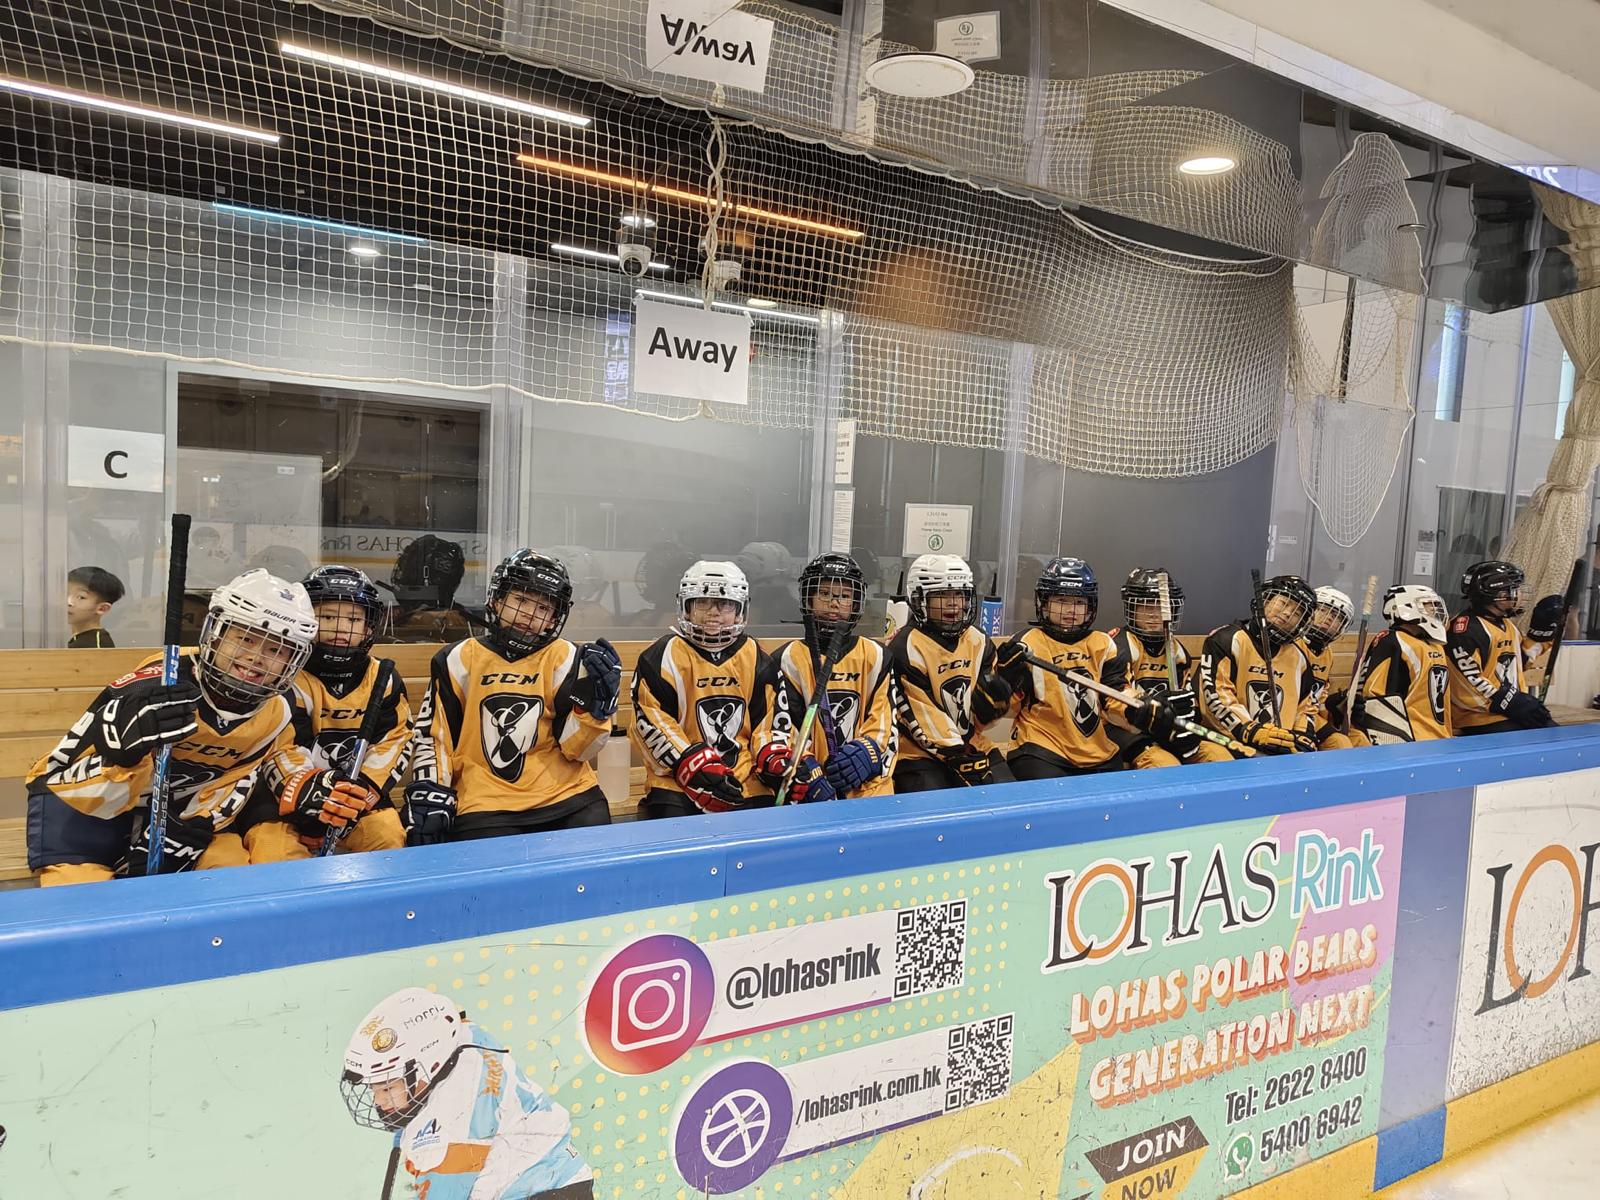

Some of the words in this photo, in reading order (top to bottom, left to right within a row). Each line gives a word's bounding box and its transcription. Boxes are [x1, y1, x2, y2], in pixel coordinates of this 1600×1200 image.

[648, 327, 737, 373] Away
[104, 450, 128, 479] C
[330, 578, 358, 586] CCM
[536, 572, 560, 585] CCM
[263, 608, 297, 625] BAUER
[938, 659, 971, 675] CCM
[1052, 651, 1092, 665] CCM
[480, 672, 540, 686] CCM
[696, 676, 740, 688] CCM
[172, 741, 243, 760] CCM
[158, 775, 172, 846] JETSPEED
[1045, 841, 1278, 968] LOHAS
[1291, 833, 1383, 914] Rink
[726, 943, 881, 1010] @lohasrink
[1071, 969, 1186, 1038] LOHAS
[1192, 946, 1289, 1005] POLAR
[1293, 924, 1376, 980] BEARS
[1297, 985, 1374, 1041] NEXT
[796, 1065, 941, 1126] /lohasrink.com.hk
[1225, 1088, 1259, 1125] Tel:
[1264, 1065, 1315, 1111] 2622
[1320, 1047, 1367, 1090] 8400
[1117, 1125, 1187, 1172] JOIN
[1260, 1115, 1311, 1162] 5400
[1317, 1096, 1363, 1139] 6942
[1121, 1165, 1178, 1200] NOW
